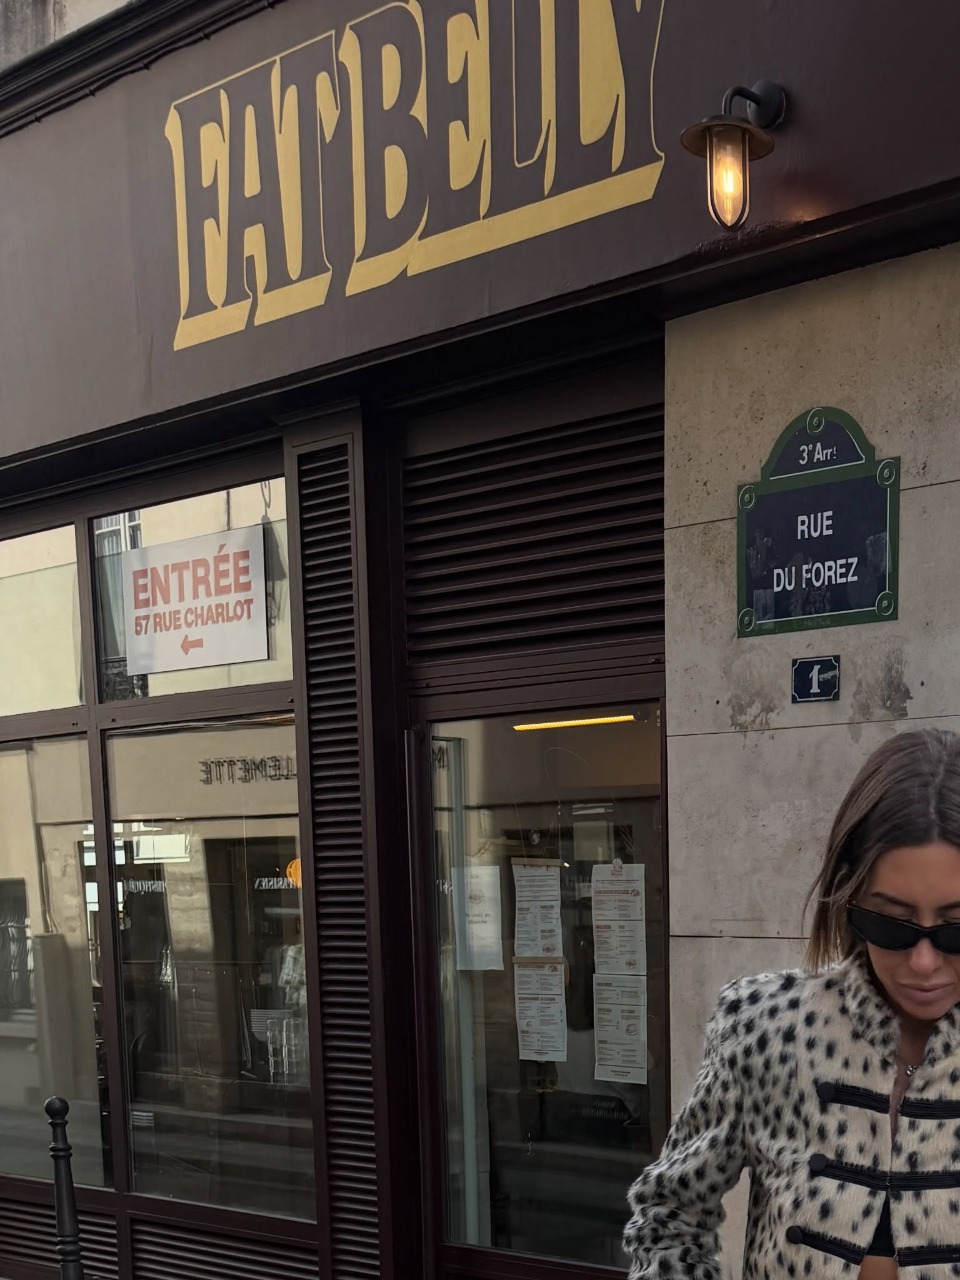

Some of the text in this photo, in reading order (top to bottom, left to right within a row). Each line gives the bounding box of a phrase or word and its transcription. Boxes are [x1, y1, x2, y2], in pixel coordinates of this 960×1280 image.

[797, 510, 833, 540] RUE
[132, 543, 252, 610] ENTRÉE
[773, 557, 858, 593] DU FOREZ
[134, 598, 254, 637] 57 RUE CHARLOT
[809, 664, 822, 694] 1
